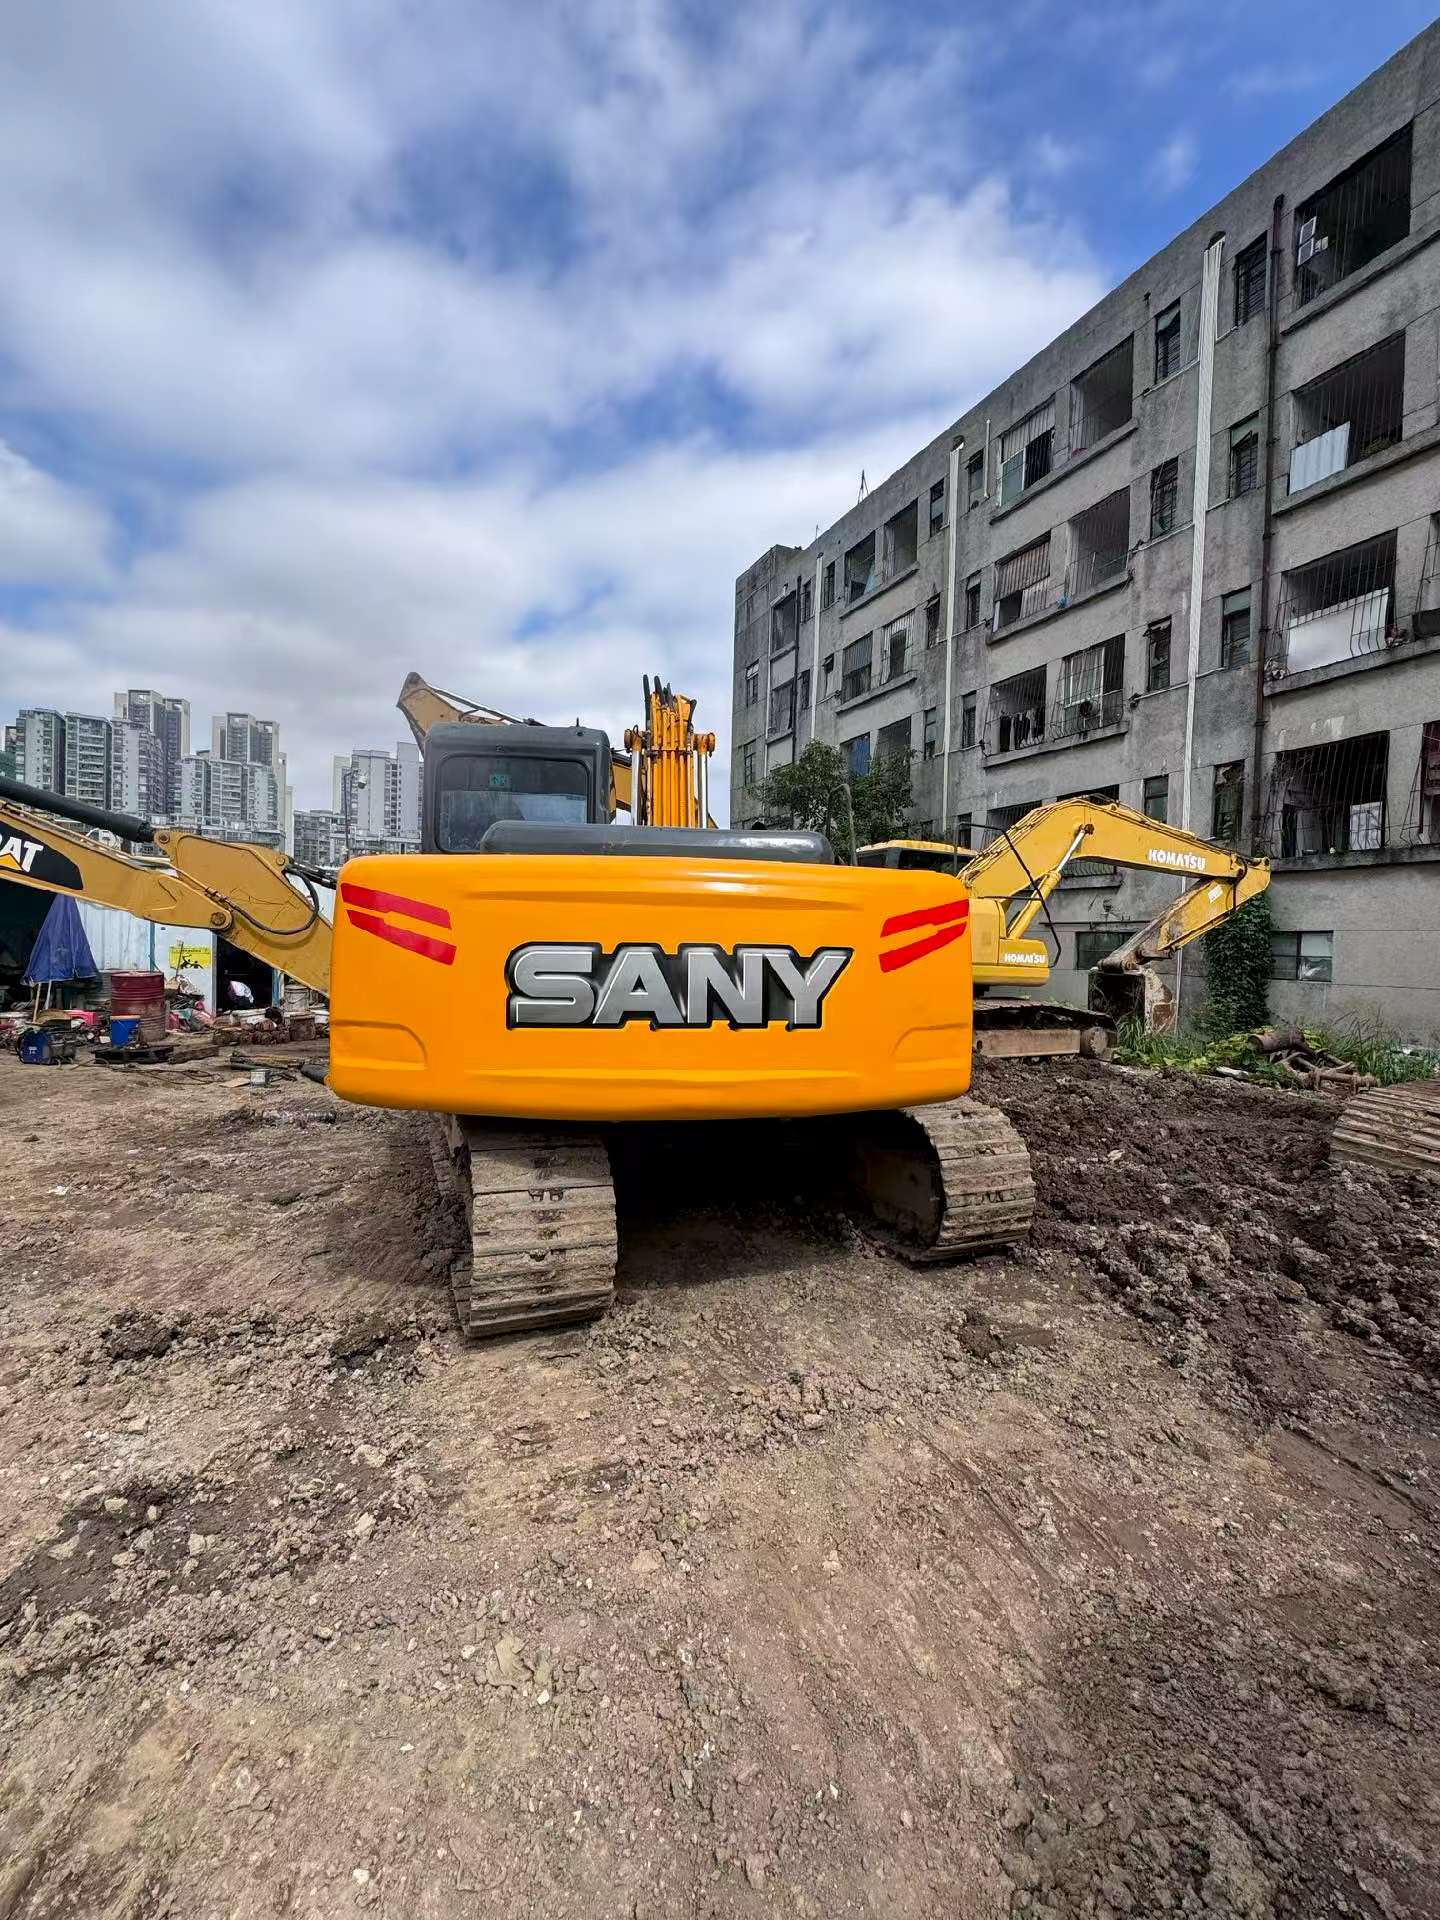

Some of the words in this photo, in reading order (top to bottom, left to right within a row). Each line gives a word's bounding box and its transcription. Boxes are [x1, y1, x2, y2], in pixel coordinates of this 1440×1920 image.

[0, 833, 44, 873] AT
[1148, 848, 1206, 871] KOMATSU
[1004, 952, 1046, 964] KOMATSU
[507, 943, 852, 1028] SANY
